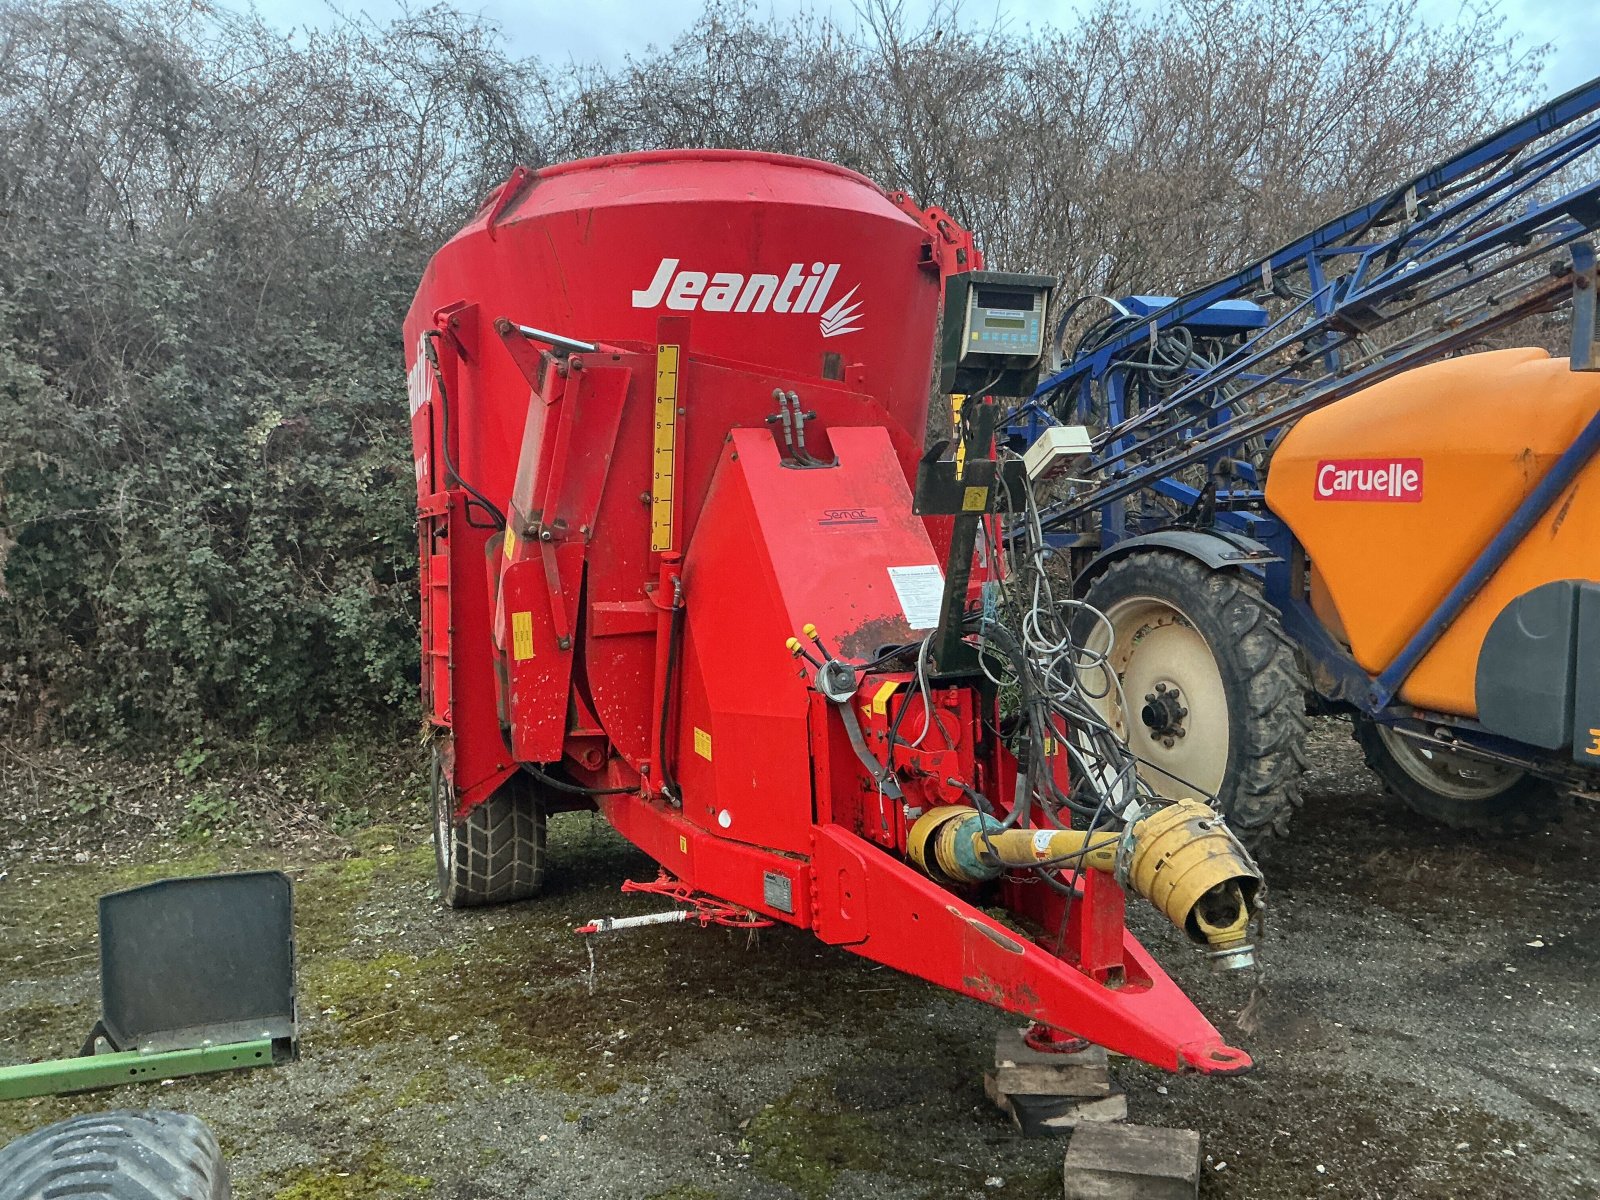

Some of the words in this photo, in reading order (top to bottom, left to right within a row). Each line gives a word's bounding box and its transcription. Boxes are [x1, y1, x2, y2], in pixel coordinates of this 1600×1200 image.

[632, 258, 841, 313] Jeantil
[660, 345, 665, 353] 8
[655, 447, 660, 455] 4
[655, 472, 660, 480] 3
[1318, 463, 1419, 497] Caruelle
